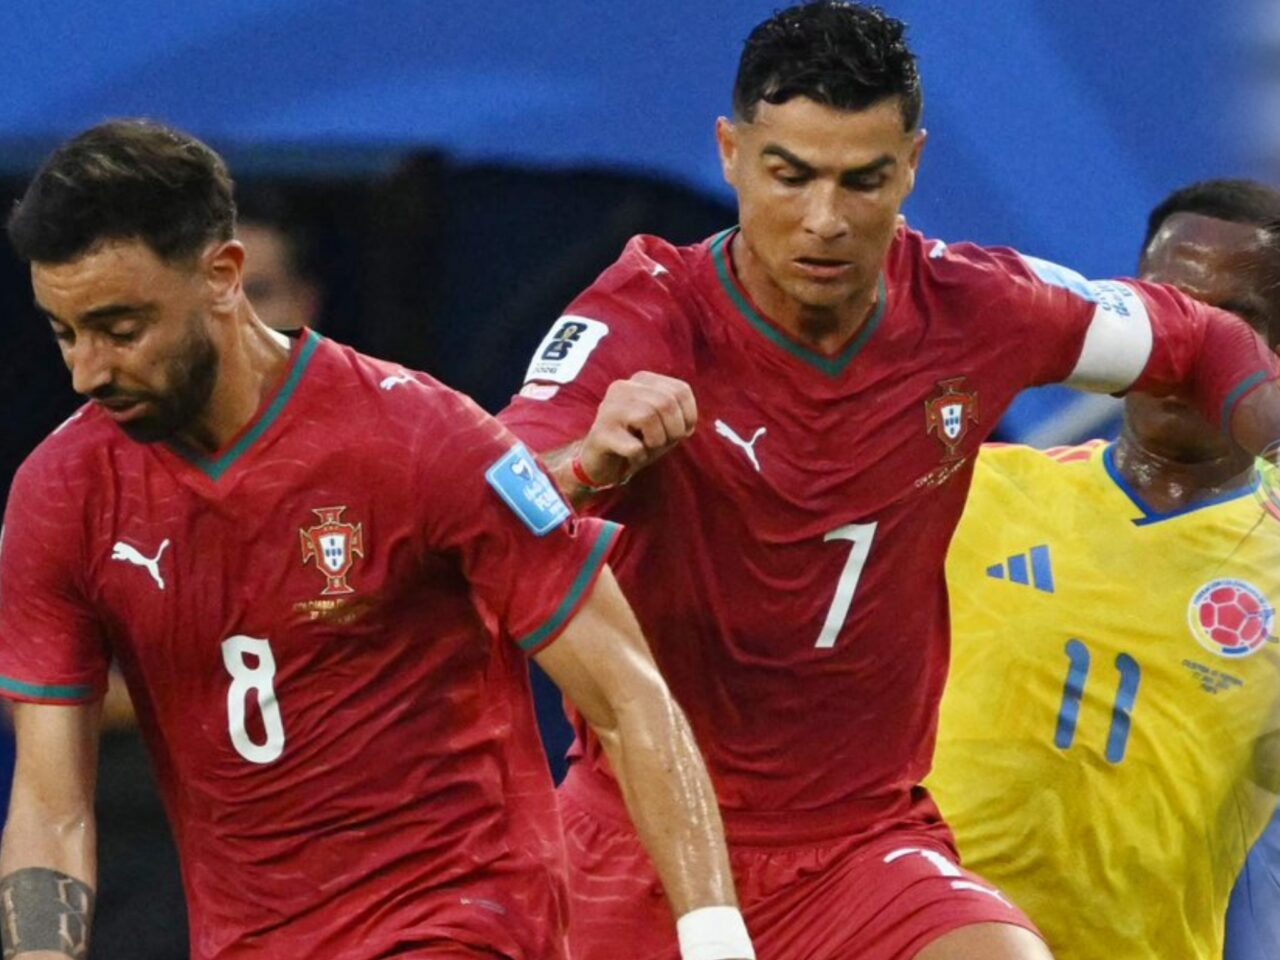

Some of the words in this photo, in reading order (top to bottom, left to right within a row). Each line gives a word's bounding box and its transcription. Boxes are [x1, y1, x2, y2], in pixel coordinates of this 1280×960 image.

[814, 521, 879, 648] 7
[220, 634, 286, 764] 8
[1053, 637, 1142, 764] 11
